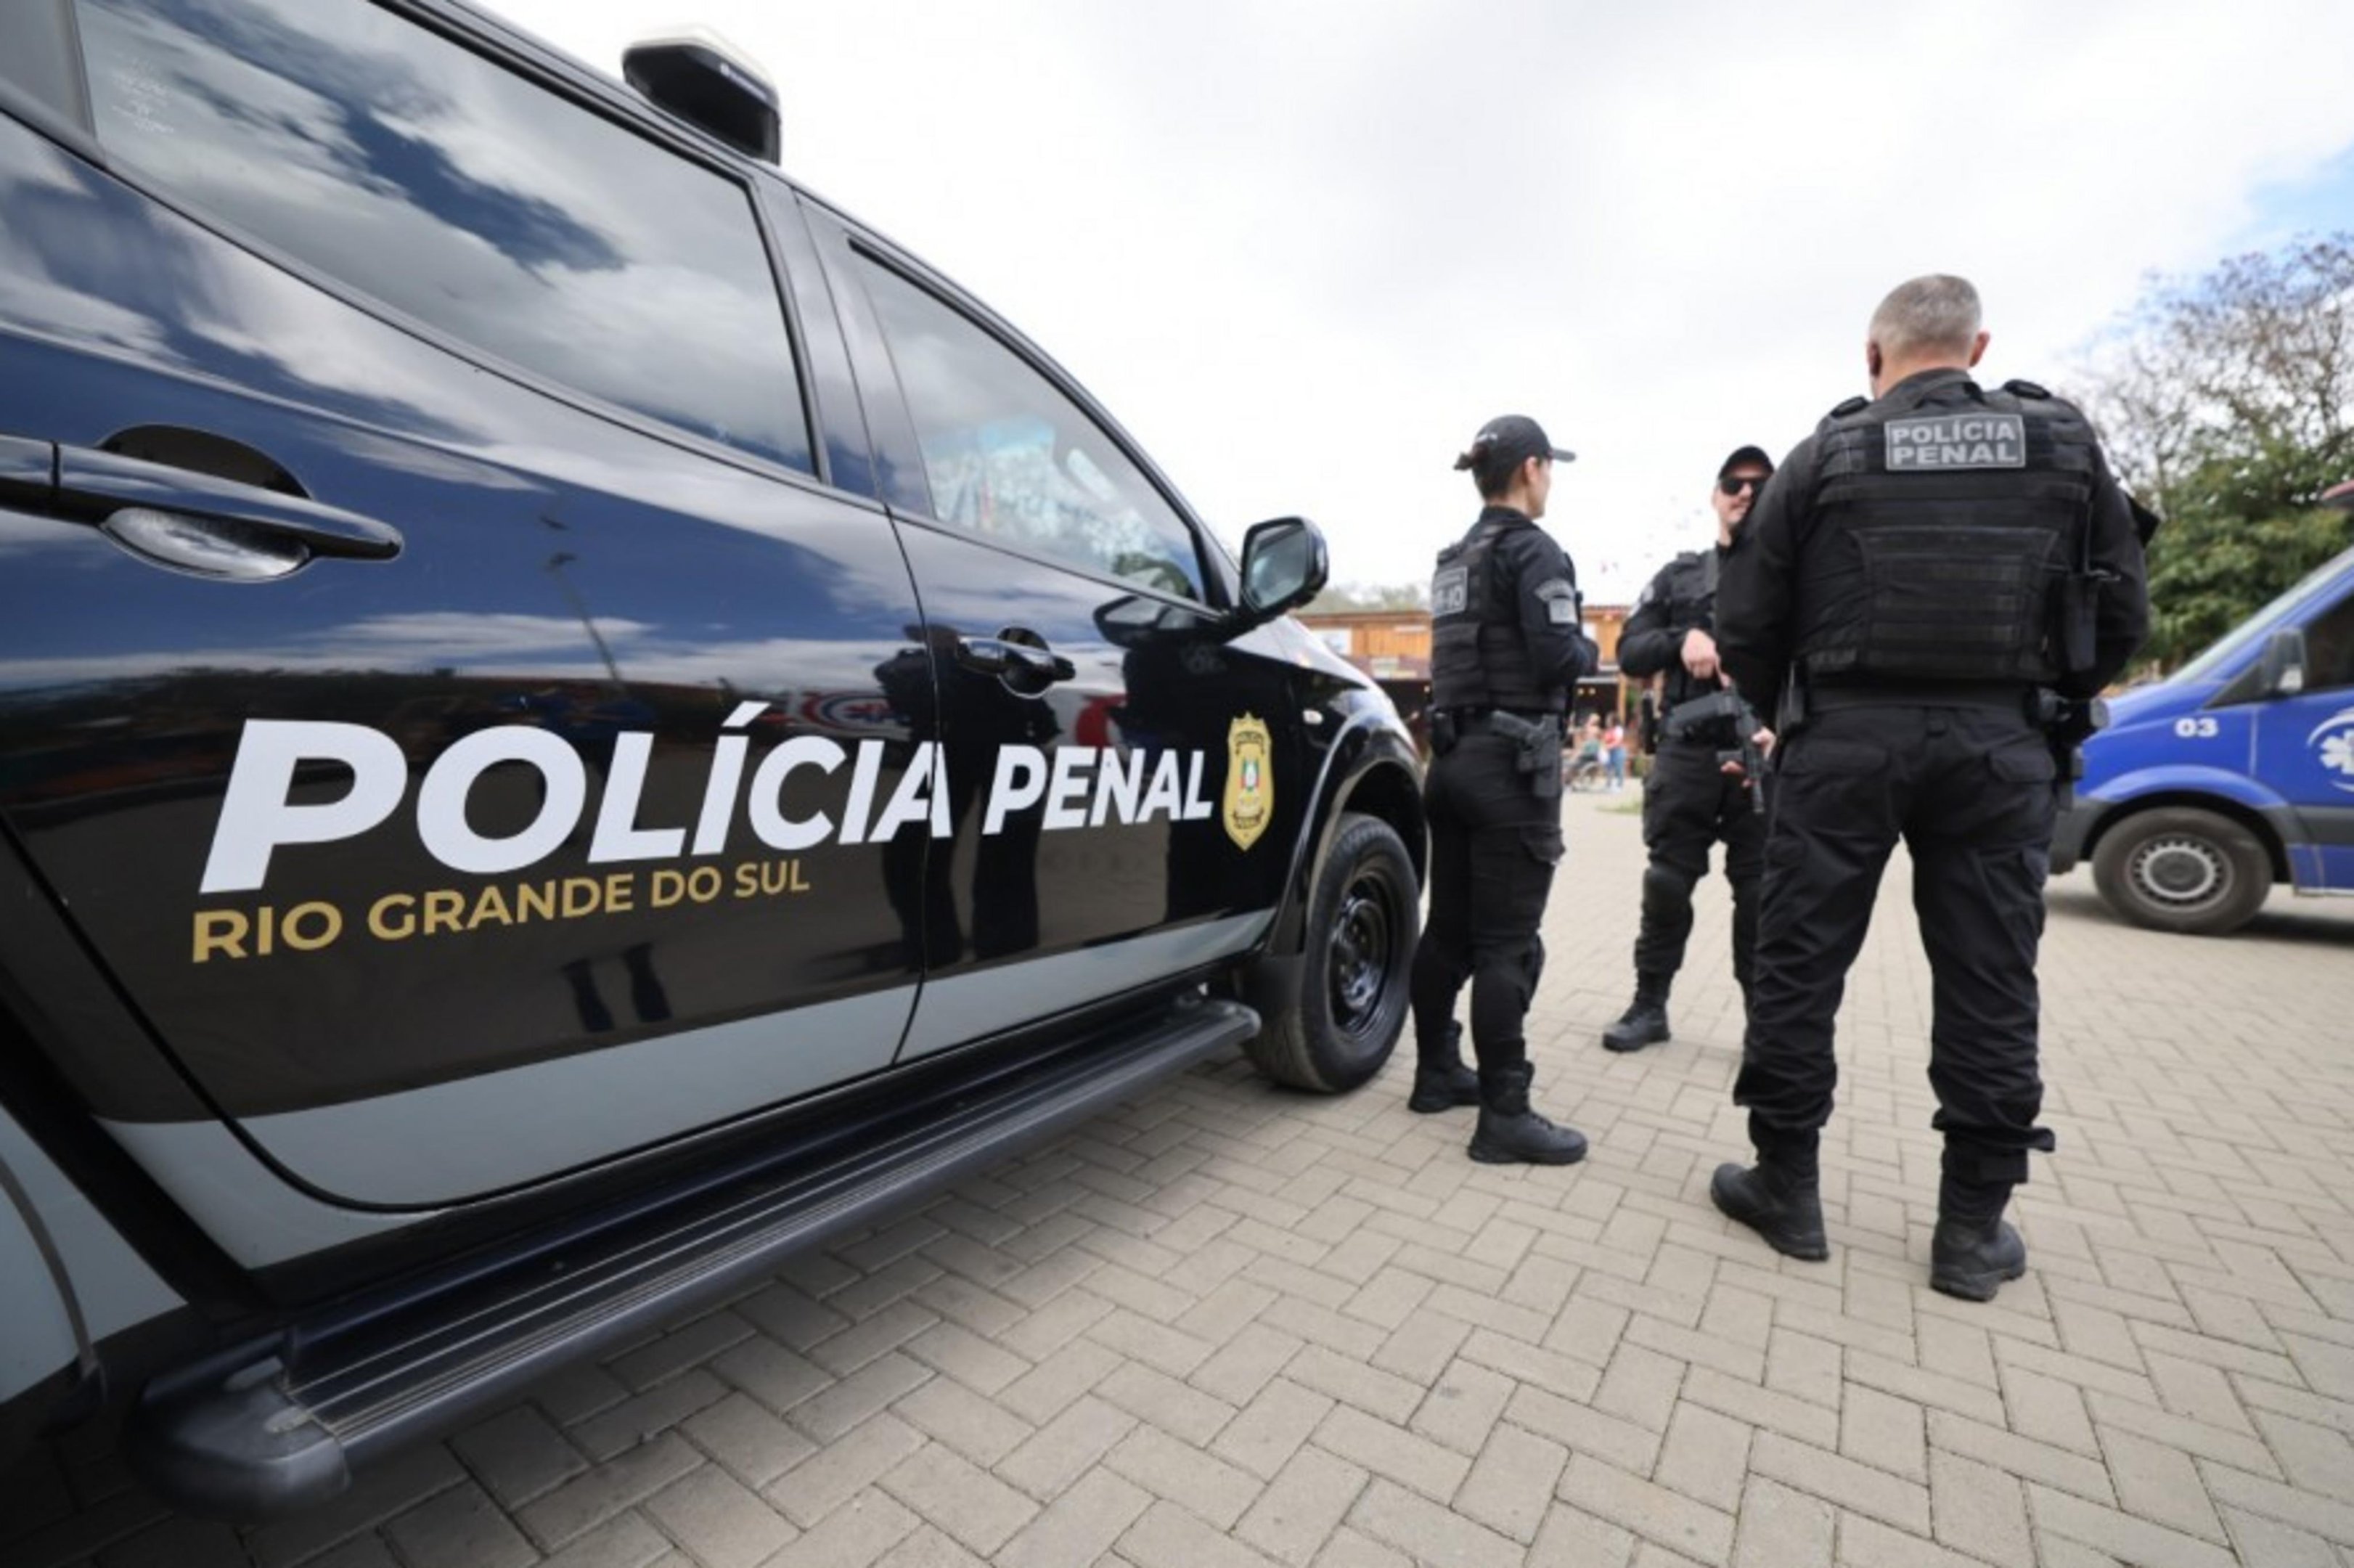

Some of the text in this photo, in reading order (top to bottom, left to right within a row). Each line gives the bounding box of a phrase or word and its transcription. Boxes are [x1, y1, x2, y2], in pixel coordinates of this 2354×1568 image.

[1892, 419, 2016, 444] POLÍCIA
[1893, 443, 2018, 465] PENAL
[2175, 717, 2218, 738] 03
[199, 701, 1214, 894] POLÍCIA PENAL
[192, 859, 810, 963] RIO GRANDE DO SUL
